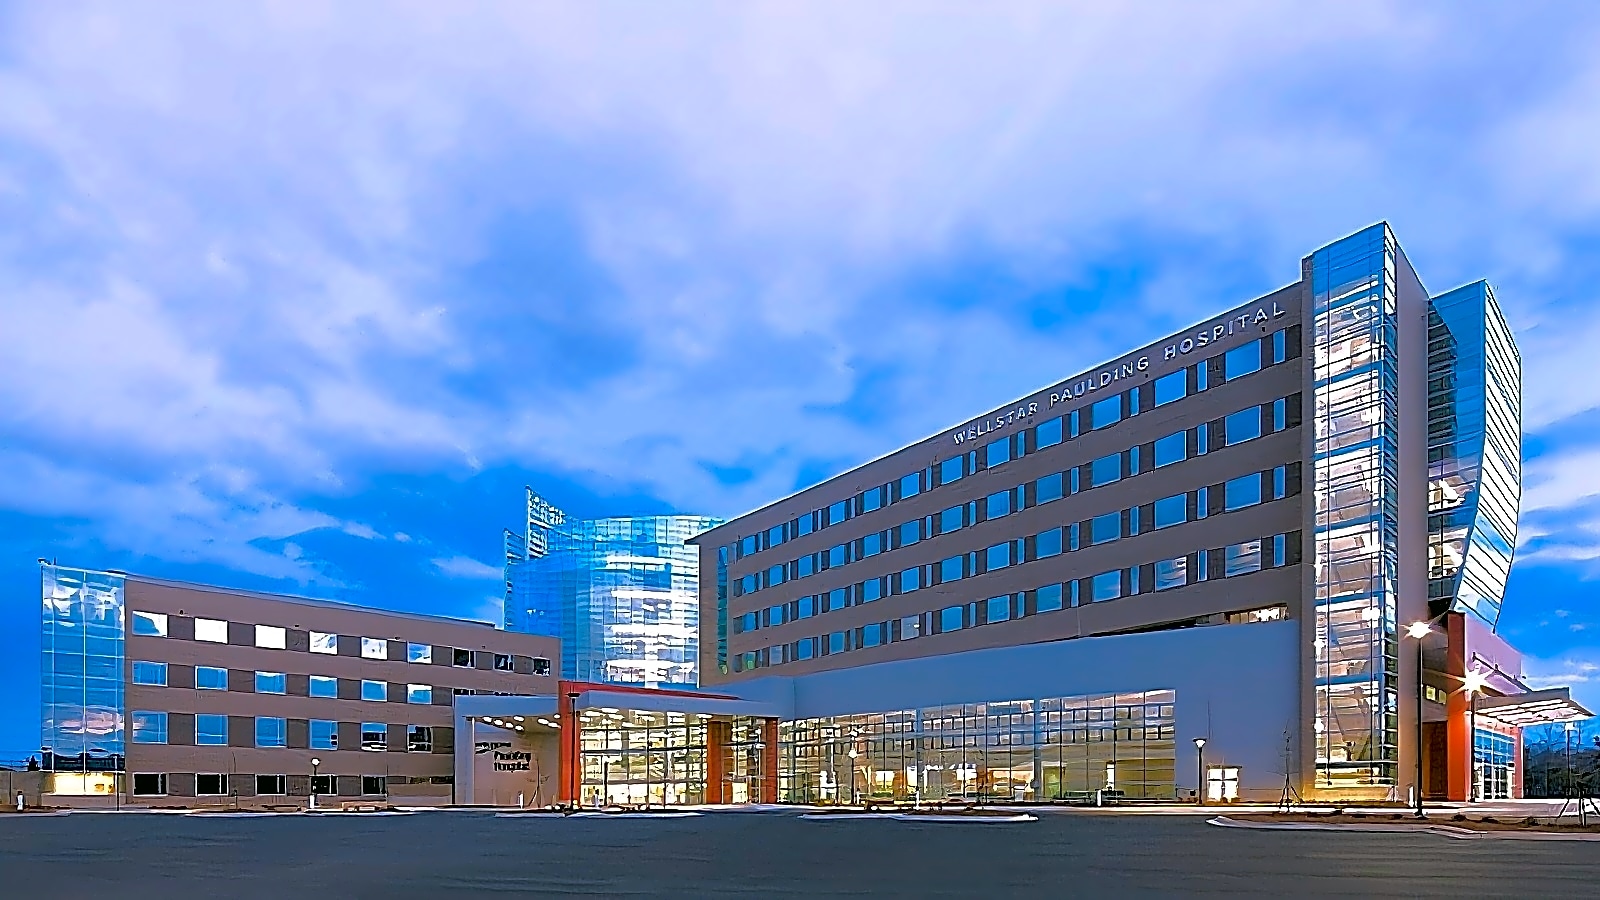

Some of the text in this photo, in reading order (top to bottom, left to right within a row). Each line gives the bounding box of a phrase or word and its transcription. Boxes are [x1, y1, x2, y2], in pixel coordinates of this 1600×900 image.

[953, 301, 1286, 444] WELLSTAR PAULDING HOSPITAL
